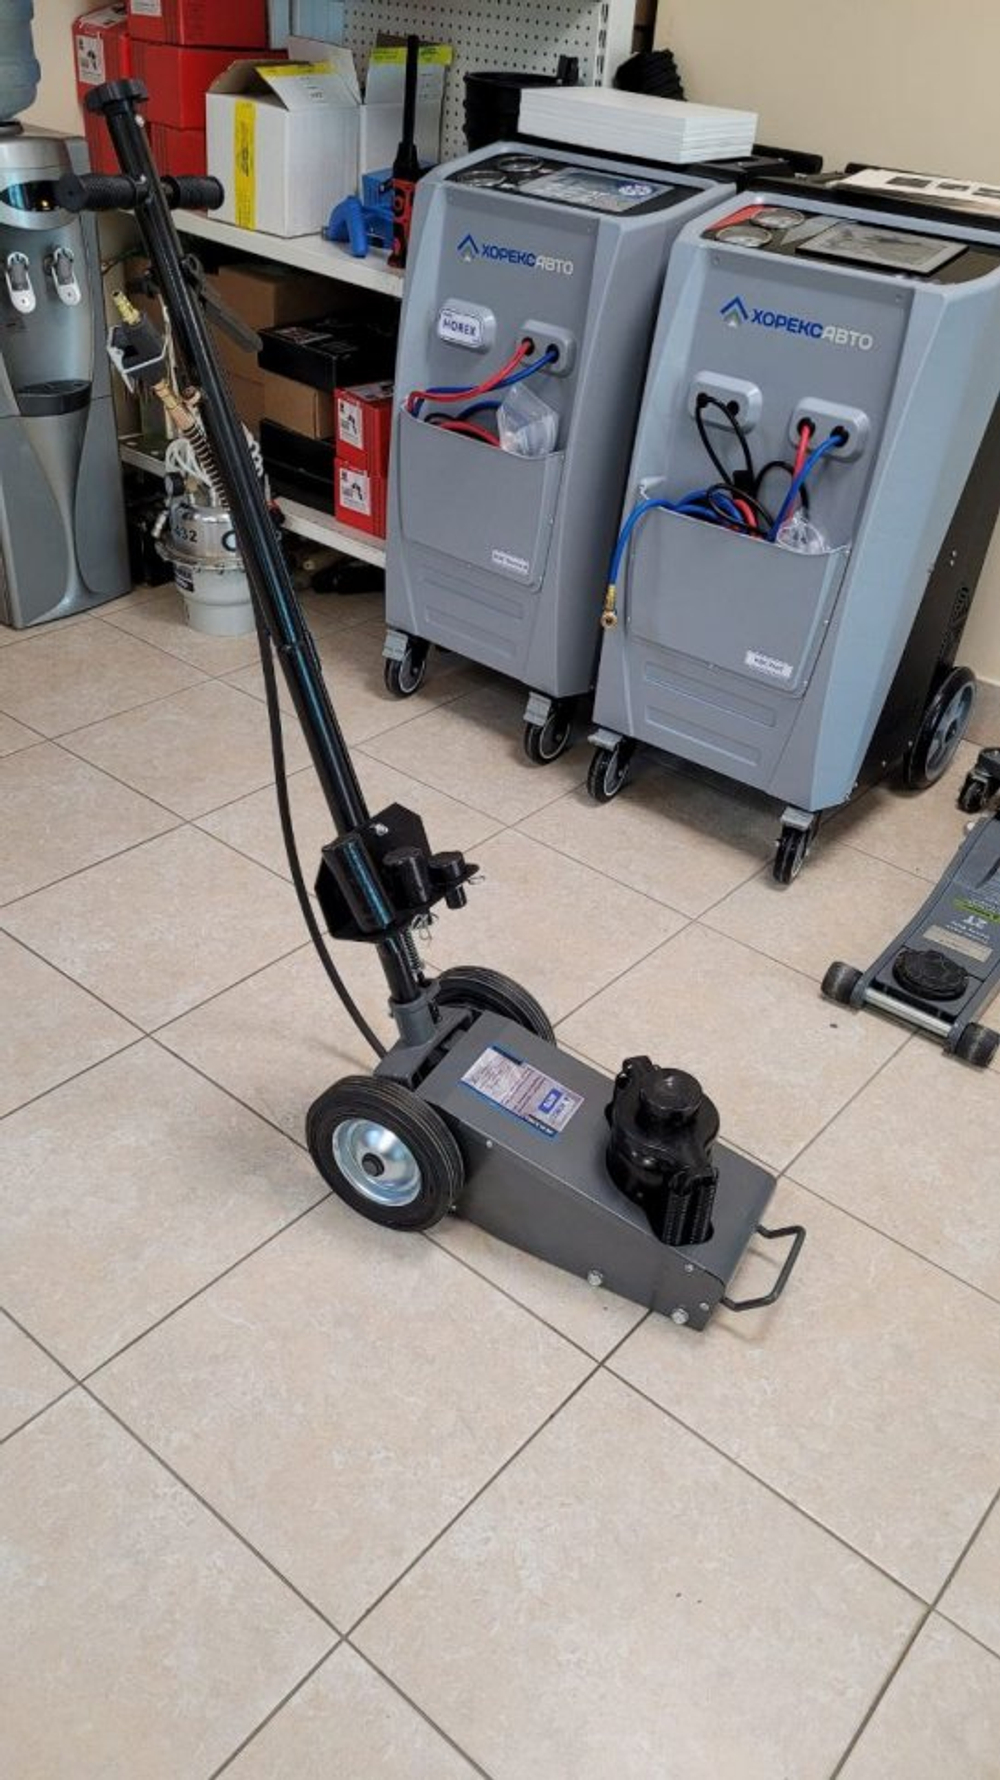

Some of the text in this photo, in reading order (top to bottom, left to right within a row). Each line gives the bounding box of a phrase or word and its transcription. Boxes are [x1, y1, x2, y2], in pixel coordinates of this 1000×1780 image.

[481, 244, 573, 275] ХОРЕКСАВТО
[442, 318, 476, 336] HOREX
[751, 308, 873, 350] ХОРЕКСАВТО
